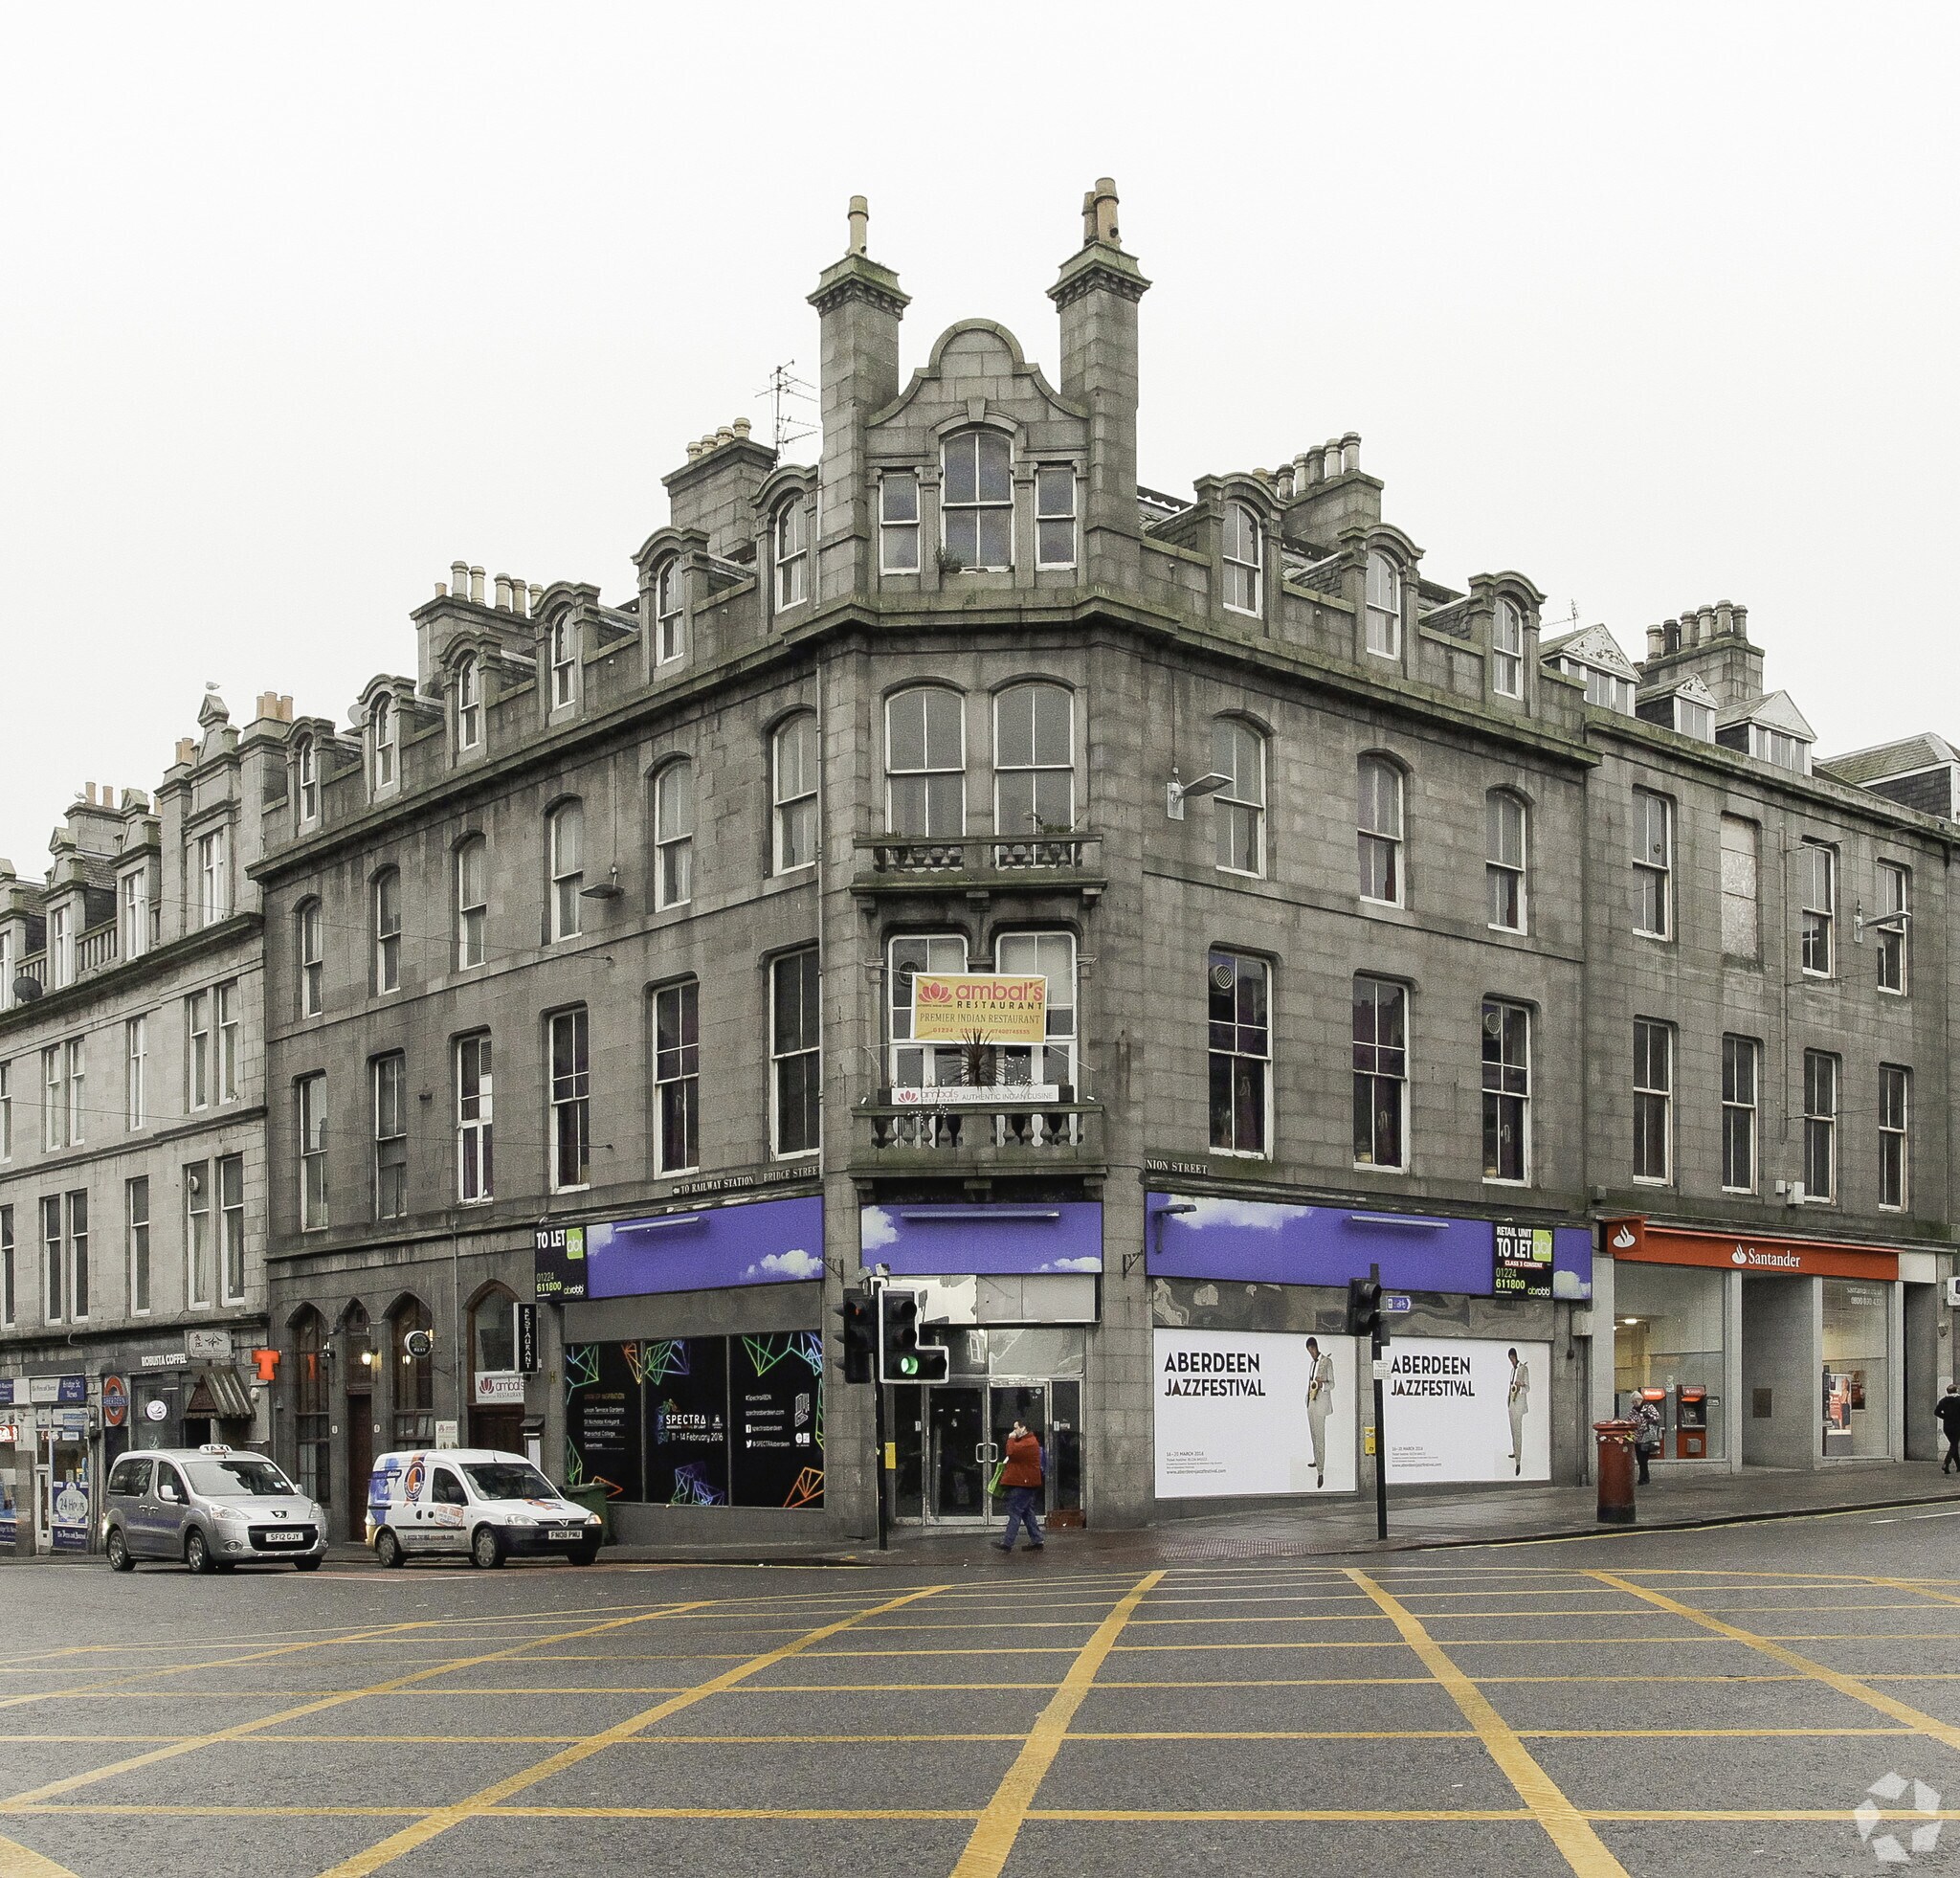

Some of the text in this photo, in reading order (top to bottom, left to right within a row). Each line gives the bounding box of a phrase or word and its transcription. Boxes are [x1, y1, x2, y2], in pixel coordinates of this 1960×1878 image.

[955, 981, 1043, 1002] ambal's
[957, 1000, 1043, 1010] RESTAURANT
[920, 1013, 1041, 1024] PREMIER INDIAN RESTAURANT
[1145, 1159, 1208, 1174] NION STREET
[764, 1169, 791, 1182] BRIDGE
[680, 1174, 754, 1195] TO RAILWAY STATION
[1496, 1226, 1532, 1238] RETAIL UNIT
[536, 1229, 566, 1249] TO LET
[1497, 1238, 1532, 1259] TO LET
[1748, 1247, 1801, 1267] Santander
[537, 1272, 554, 1282] 01224
[1496, 1267, 1517, 1278] 01224
[536, 1282, 562, 1291] 611800
[1496, 1278, 1526, 1289] 611800
[1164, 1352, 1260, 1373] ABERDEEN
[1391, 1355, 1470, 1375] ABERDEEN
[1164, 1378, 1266, 1397] JAZZFESTIVAL
[1391, 1379, 1476, 1397] JAZZFESTIVAL
[666, 1414, 706, 1424] SPECTRA
[686, 1432, 710, 1443] February
[59, 1497, 67, 1510] 24
